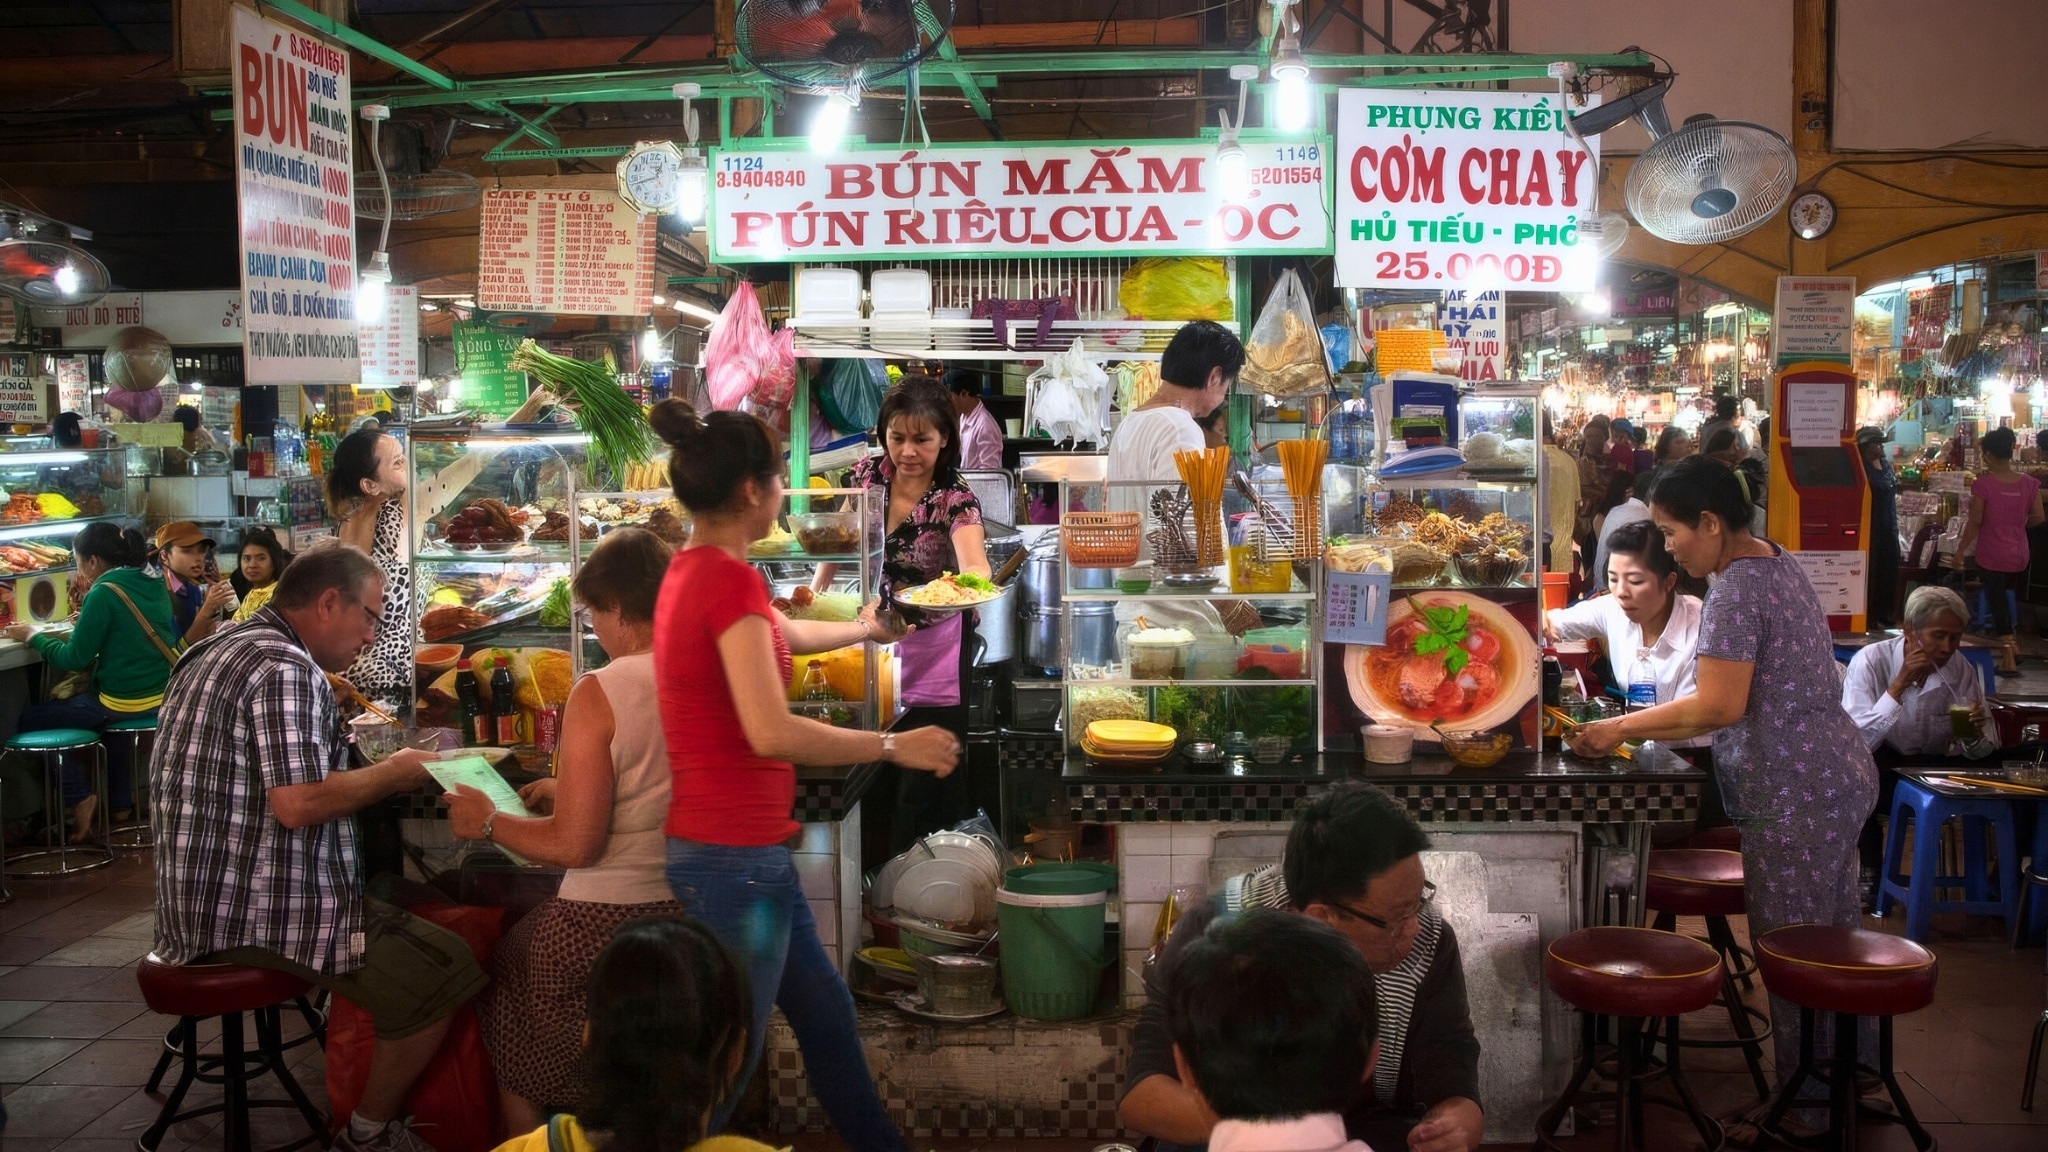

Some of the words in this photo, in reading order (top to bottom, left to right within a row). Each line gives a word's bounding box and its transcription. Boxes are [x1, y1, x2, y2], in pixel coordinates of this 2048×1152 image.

[240, 33, 308, 152] BÚN
[1367, 105, 1481, 134] PHỤNG
[724, 157, 763, 171] 1124
[1277, 147, 1318, 161] 1148
[1350, 133, 1446, 204] CƠM
[1458, 147, 1588, 207] CHAY
[825, 151, 981, 199] BÚN
[1003, 147, 1205, 195] MẮM
[1351, 210, 1396, 241] HỦ
[1407, 212, 1484, 243] TIẾU
[1376, 251, 1562, 283] 25.000Đ
